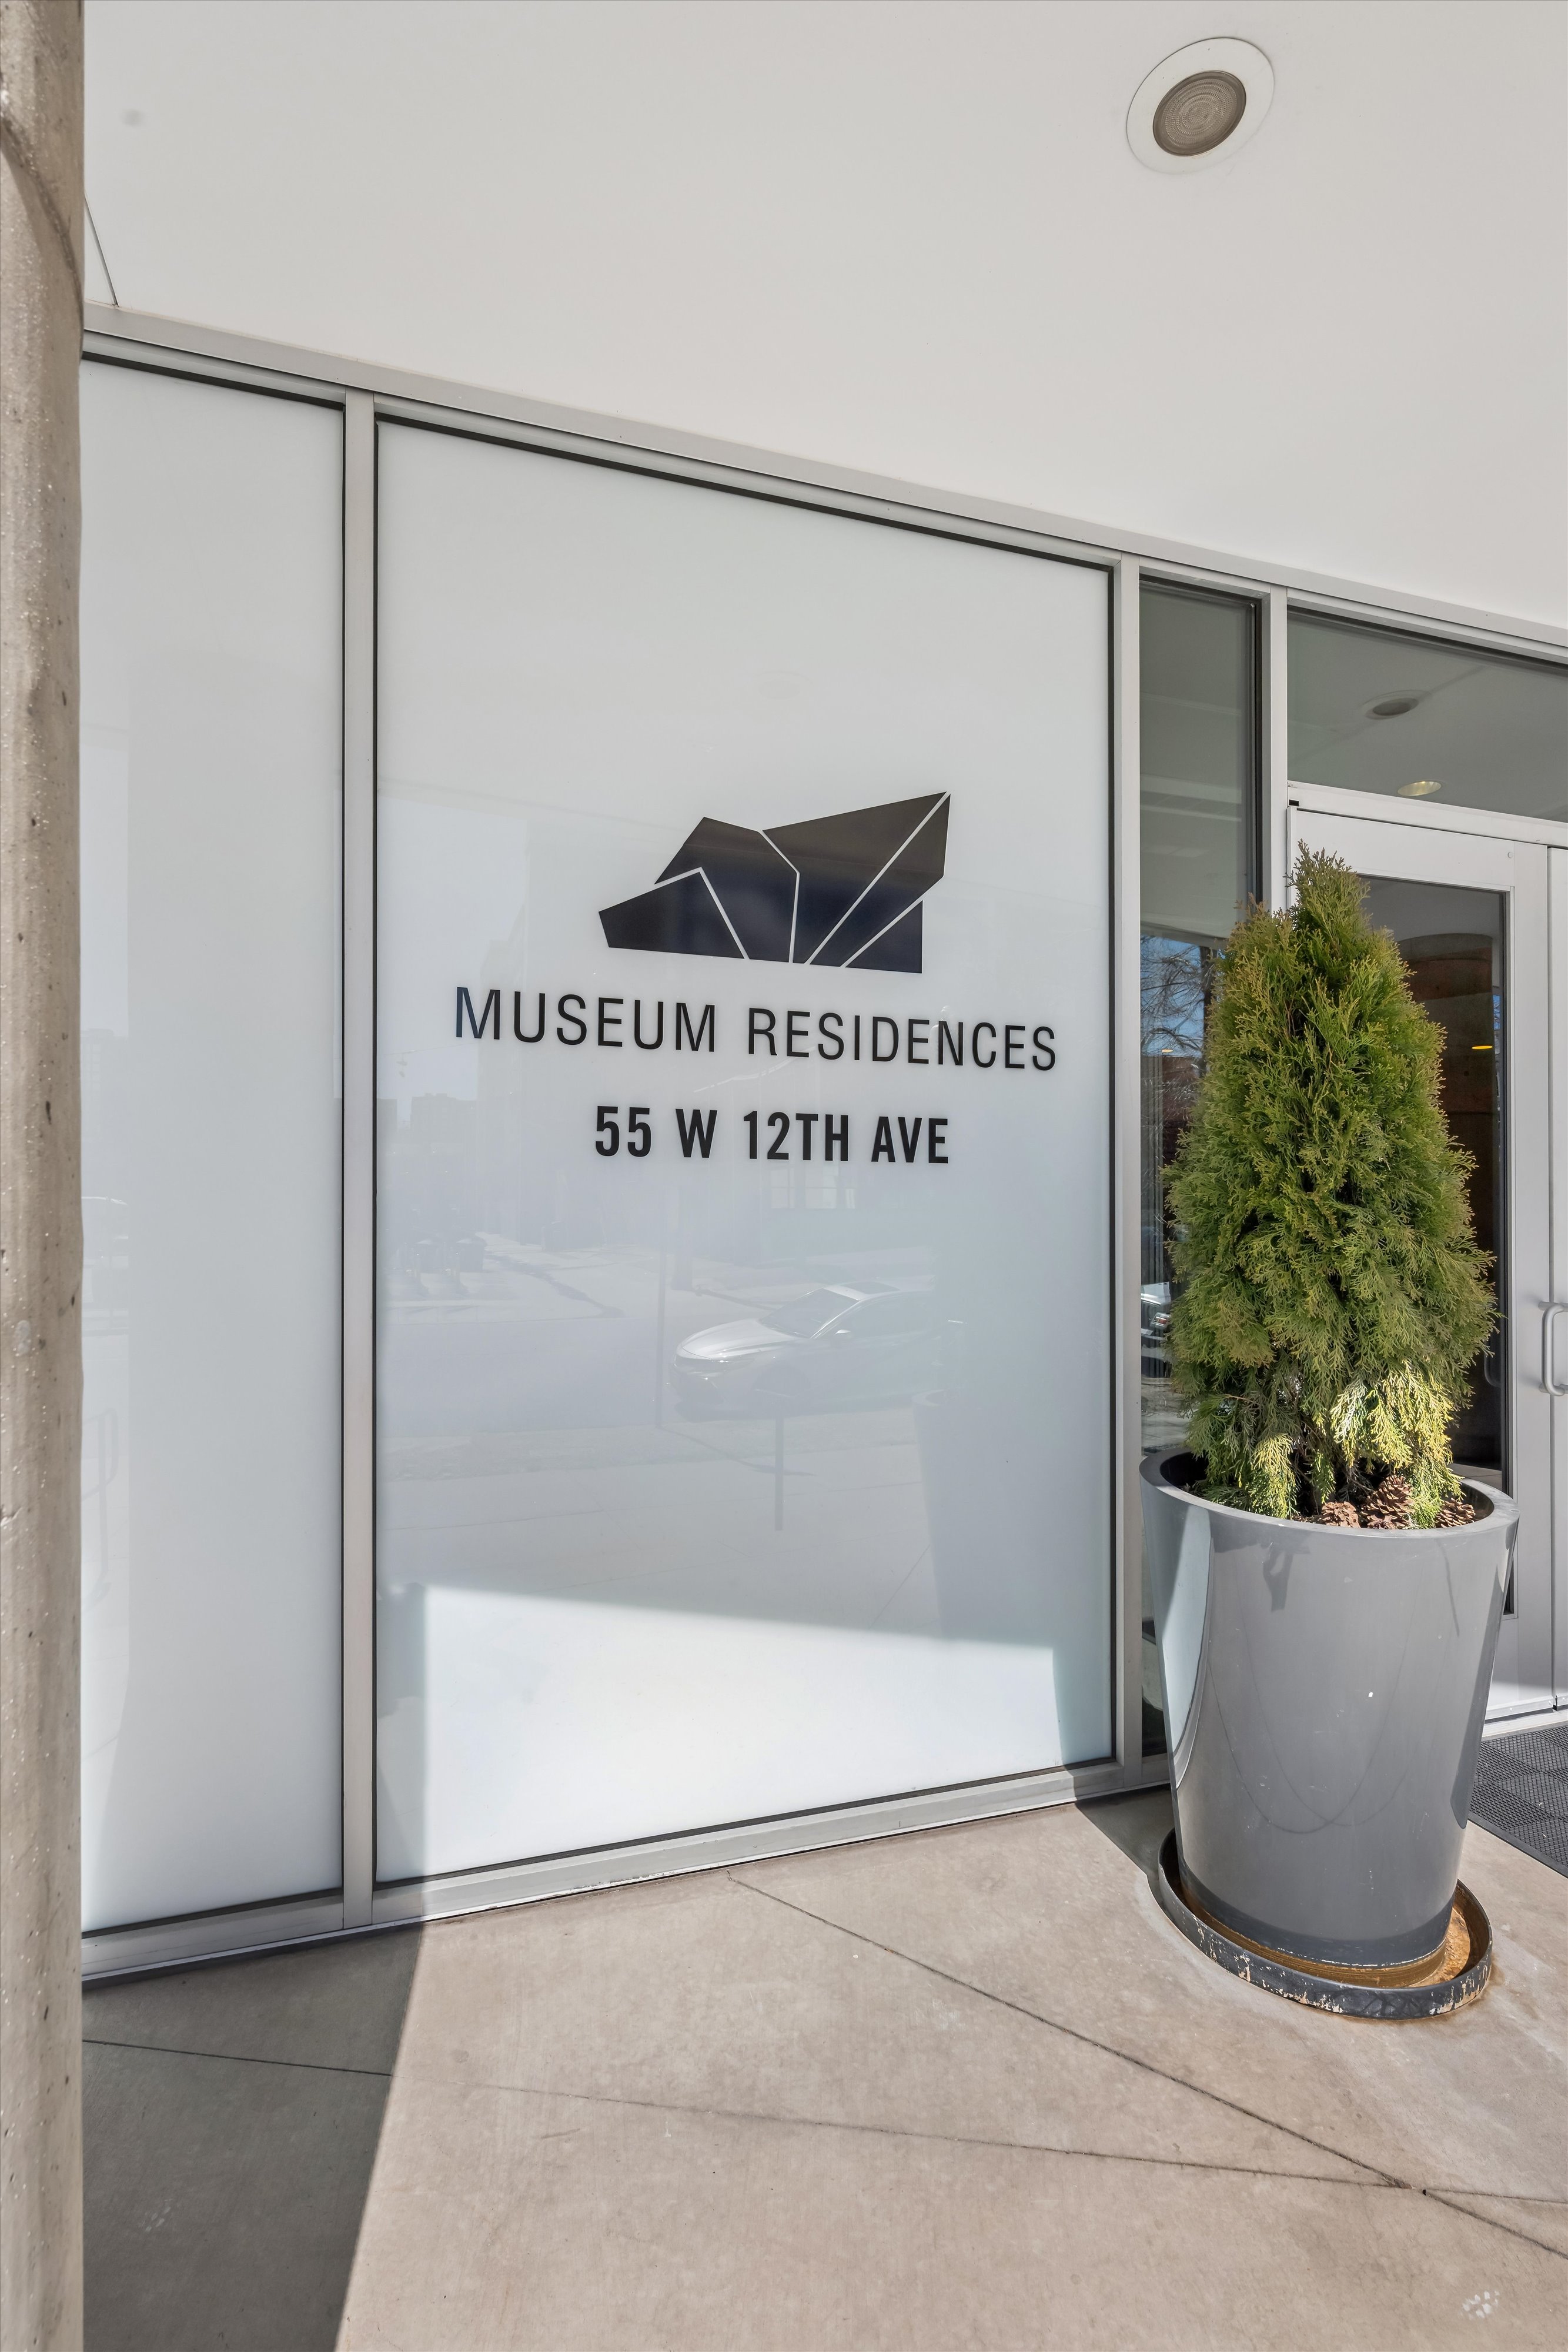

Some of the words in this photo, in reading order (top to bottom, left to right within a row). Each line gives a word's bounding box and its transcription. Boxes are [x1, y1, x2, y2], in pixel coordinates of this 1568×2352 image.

[455, 987, 716, 1053] MUSEUM
[748, 1007, 1057, 1072] RESIDENCES
[594, 1105, 652, 1158] 55
[674, 1108, 718, 1159] W
[743, 1110, 850, 1162] 12TH
[870, 1116, 950, 1164] AVE
